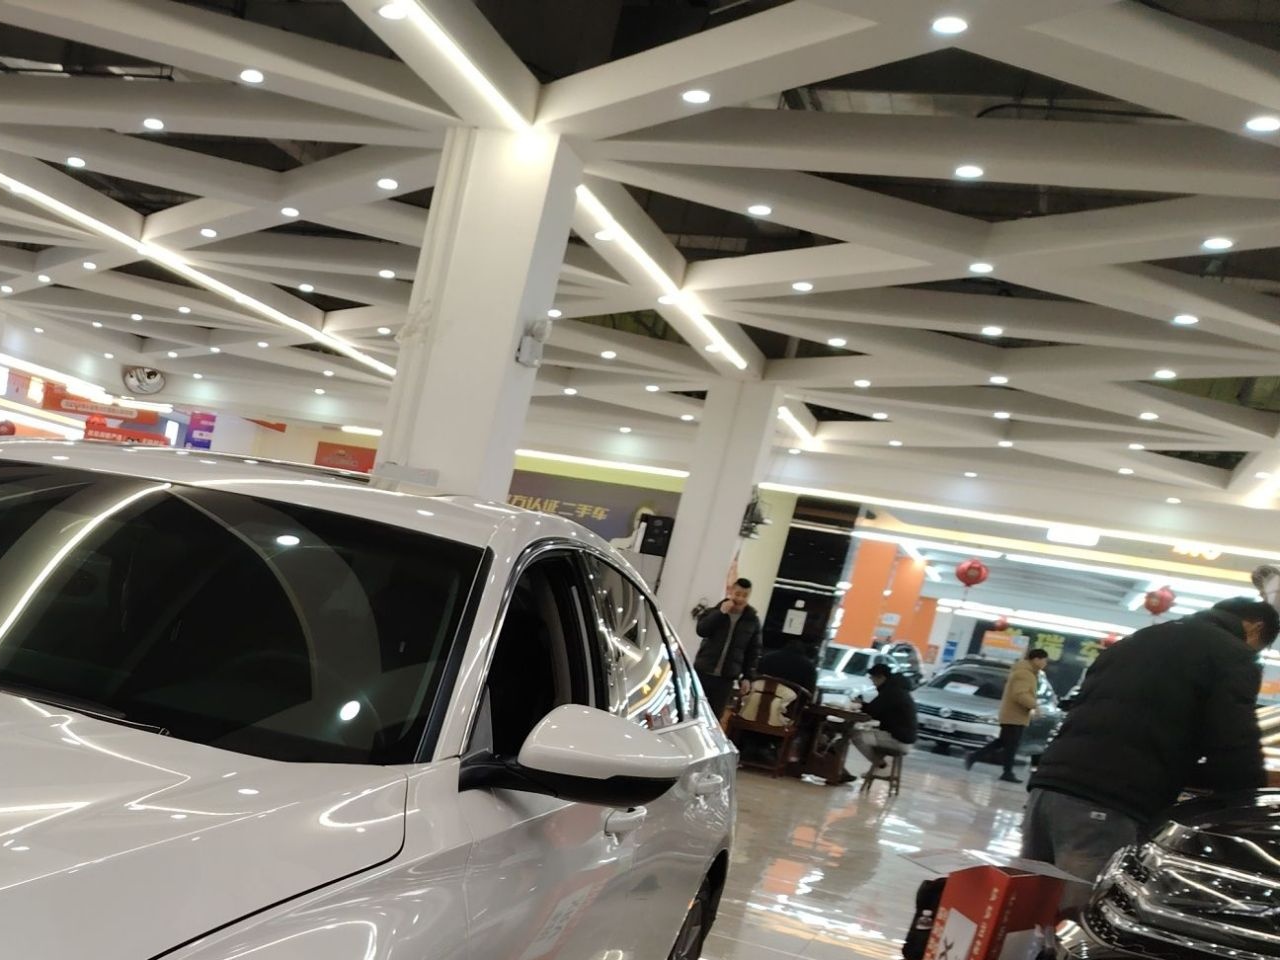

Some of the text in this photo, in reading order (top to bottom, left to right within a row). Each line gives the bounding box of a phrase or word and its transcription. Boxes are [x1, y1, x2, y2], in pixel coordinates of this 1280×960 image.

[508, 494, 611, 520] 方认证二手车
